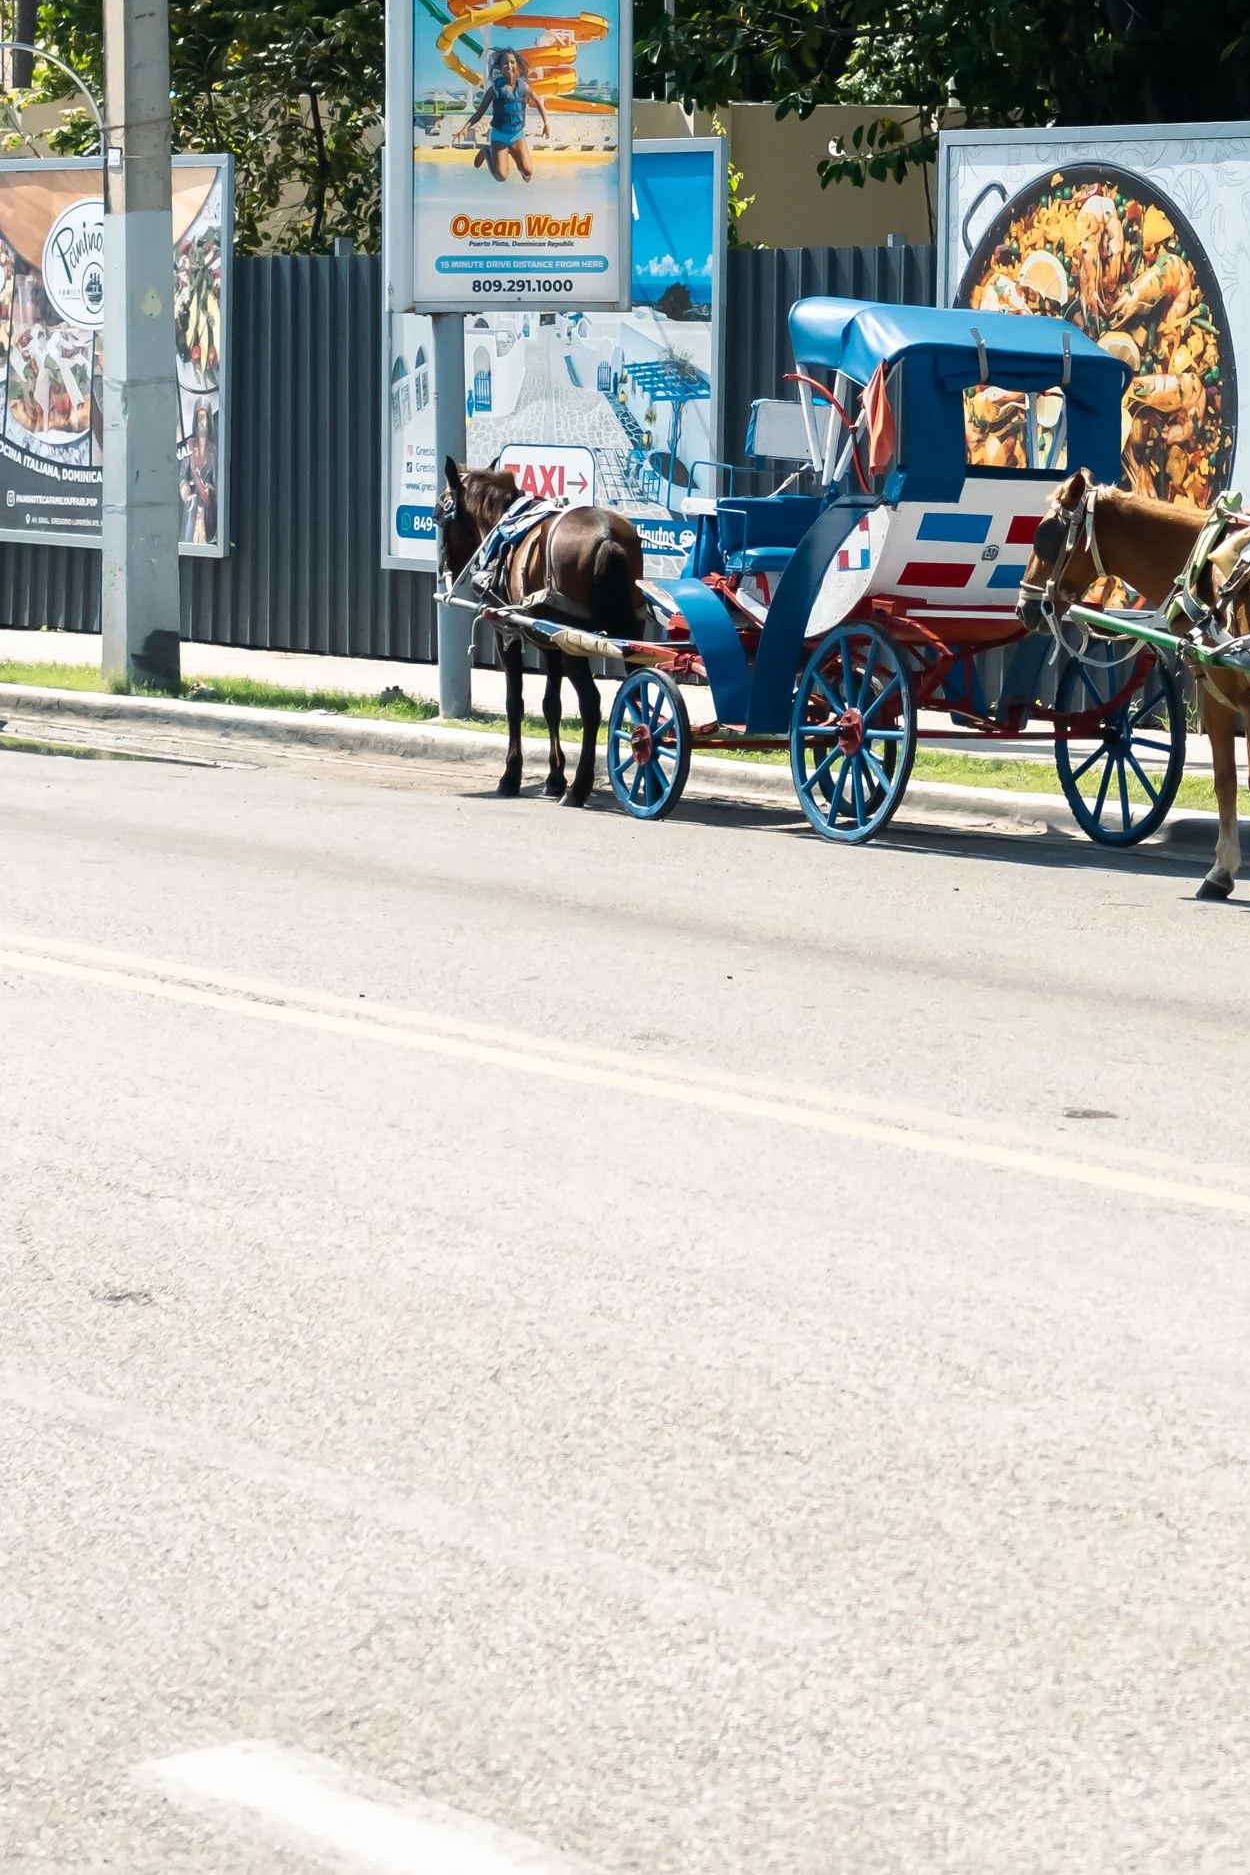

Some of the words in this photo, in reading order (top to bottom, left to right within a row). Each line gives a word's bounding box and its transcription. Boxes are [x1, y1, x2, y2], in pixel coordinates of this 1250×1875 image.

[450, 213, 524, 239] Ocean
[525, 212, 593, 239] World
[51, 221, 104, 285] Panino
[547, 240, 574, 248] Republic
[440, 261, 449, 269] 15
[582, 260, 604, 268] HERE
[472, 279, 573, 293] 809.291.1000
[23, 454, 61, 481] ITALIANA,
